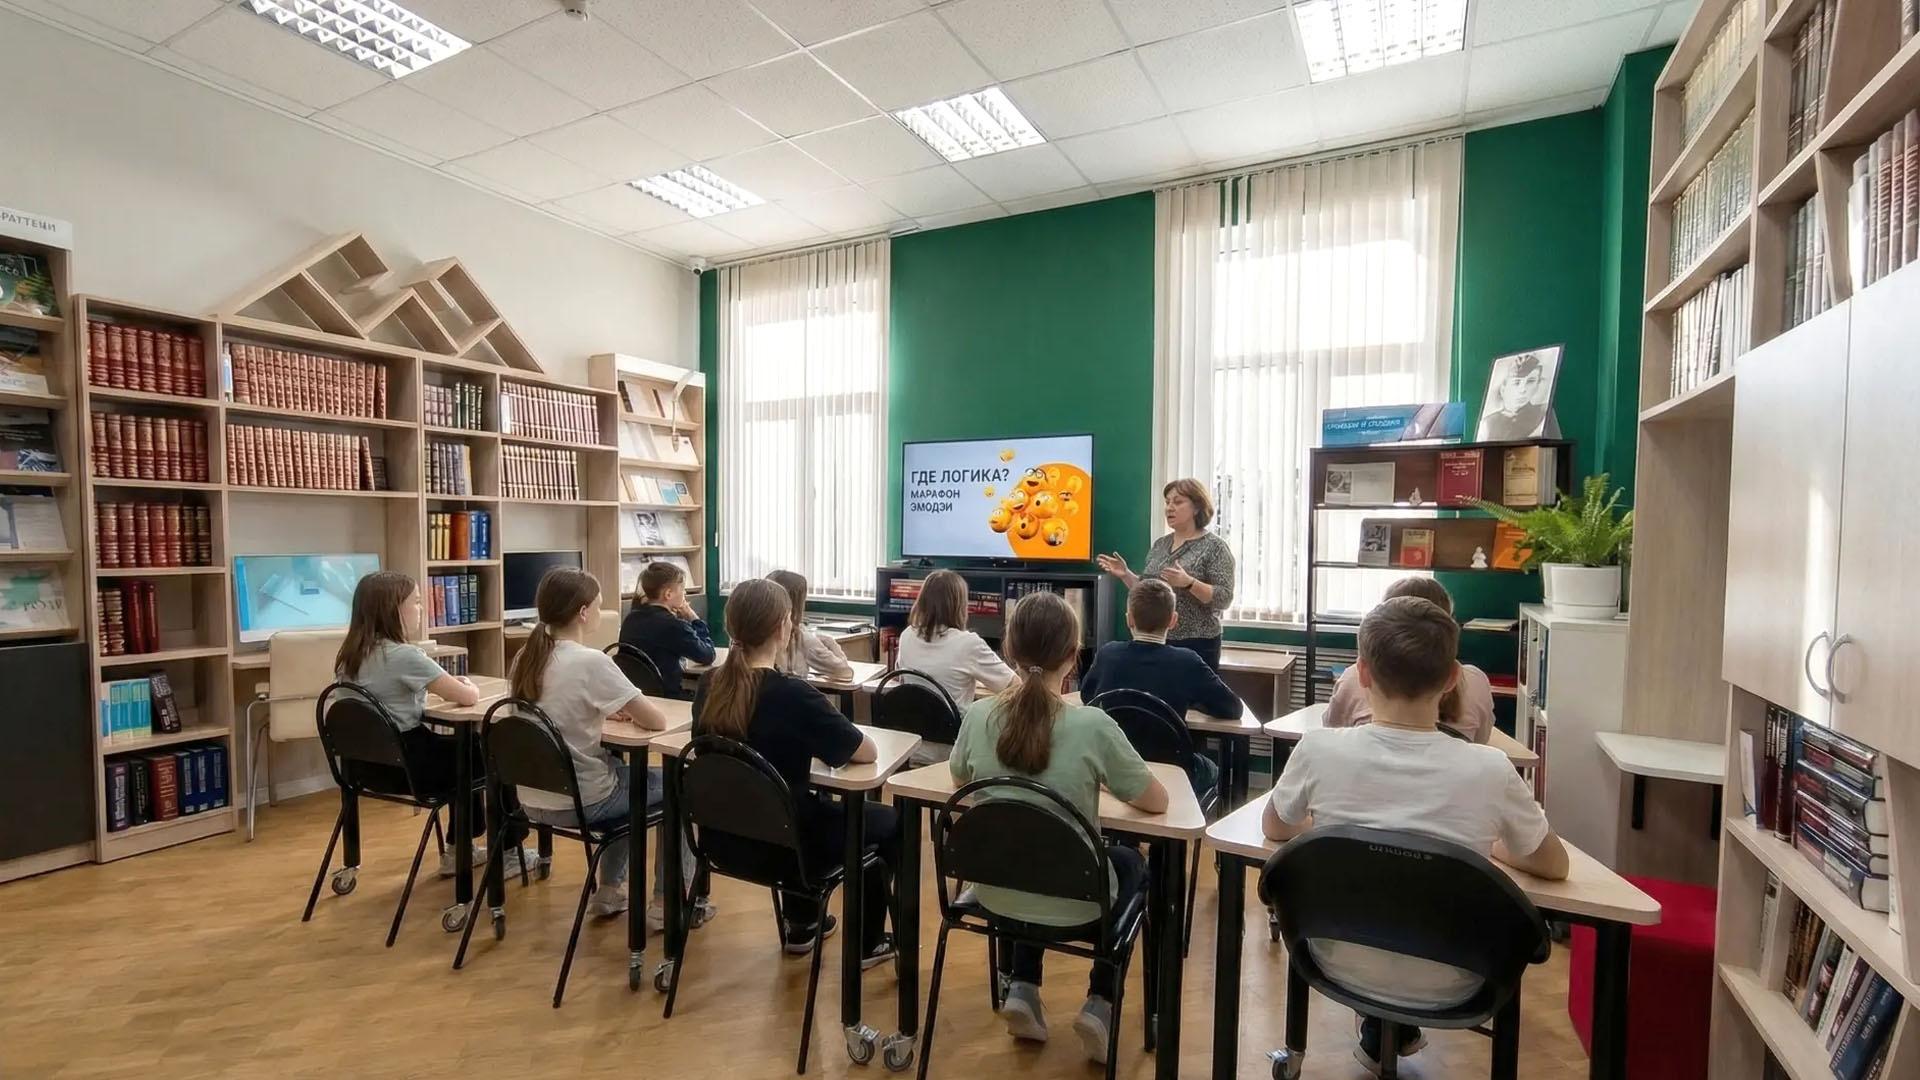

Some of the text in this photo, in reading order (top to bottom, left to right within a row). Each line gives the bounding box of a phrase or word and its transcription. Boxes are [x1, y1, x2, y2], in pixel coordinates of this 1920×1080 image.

[911, 468, 1010, 486] ГДЕ ЛОГИКА?
[910, 489, 960, 499] МАРАФОН
